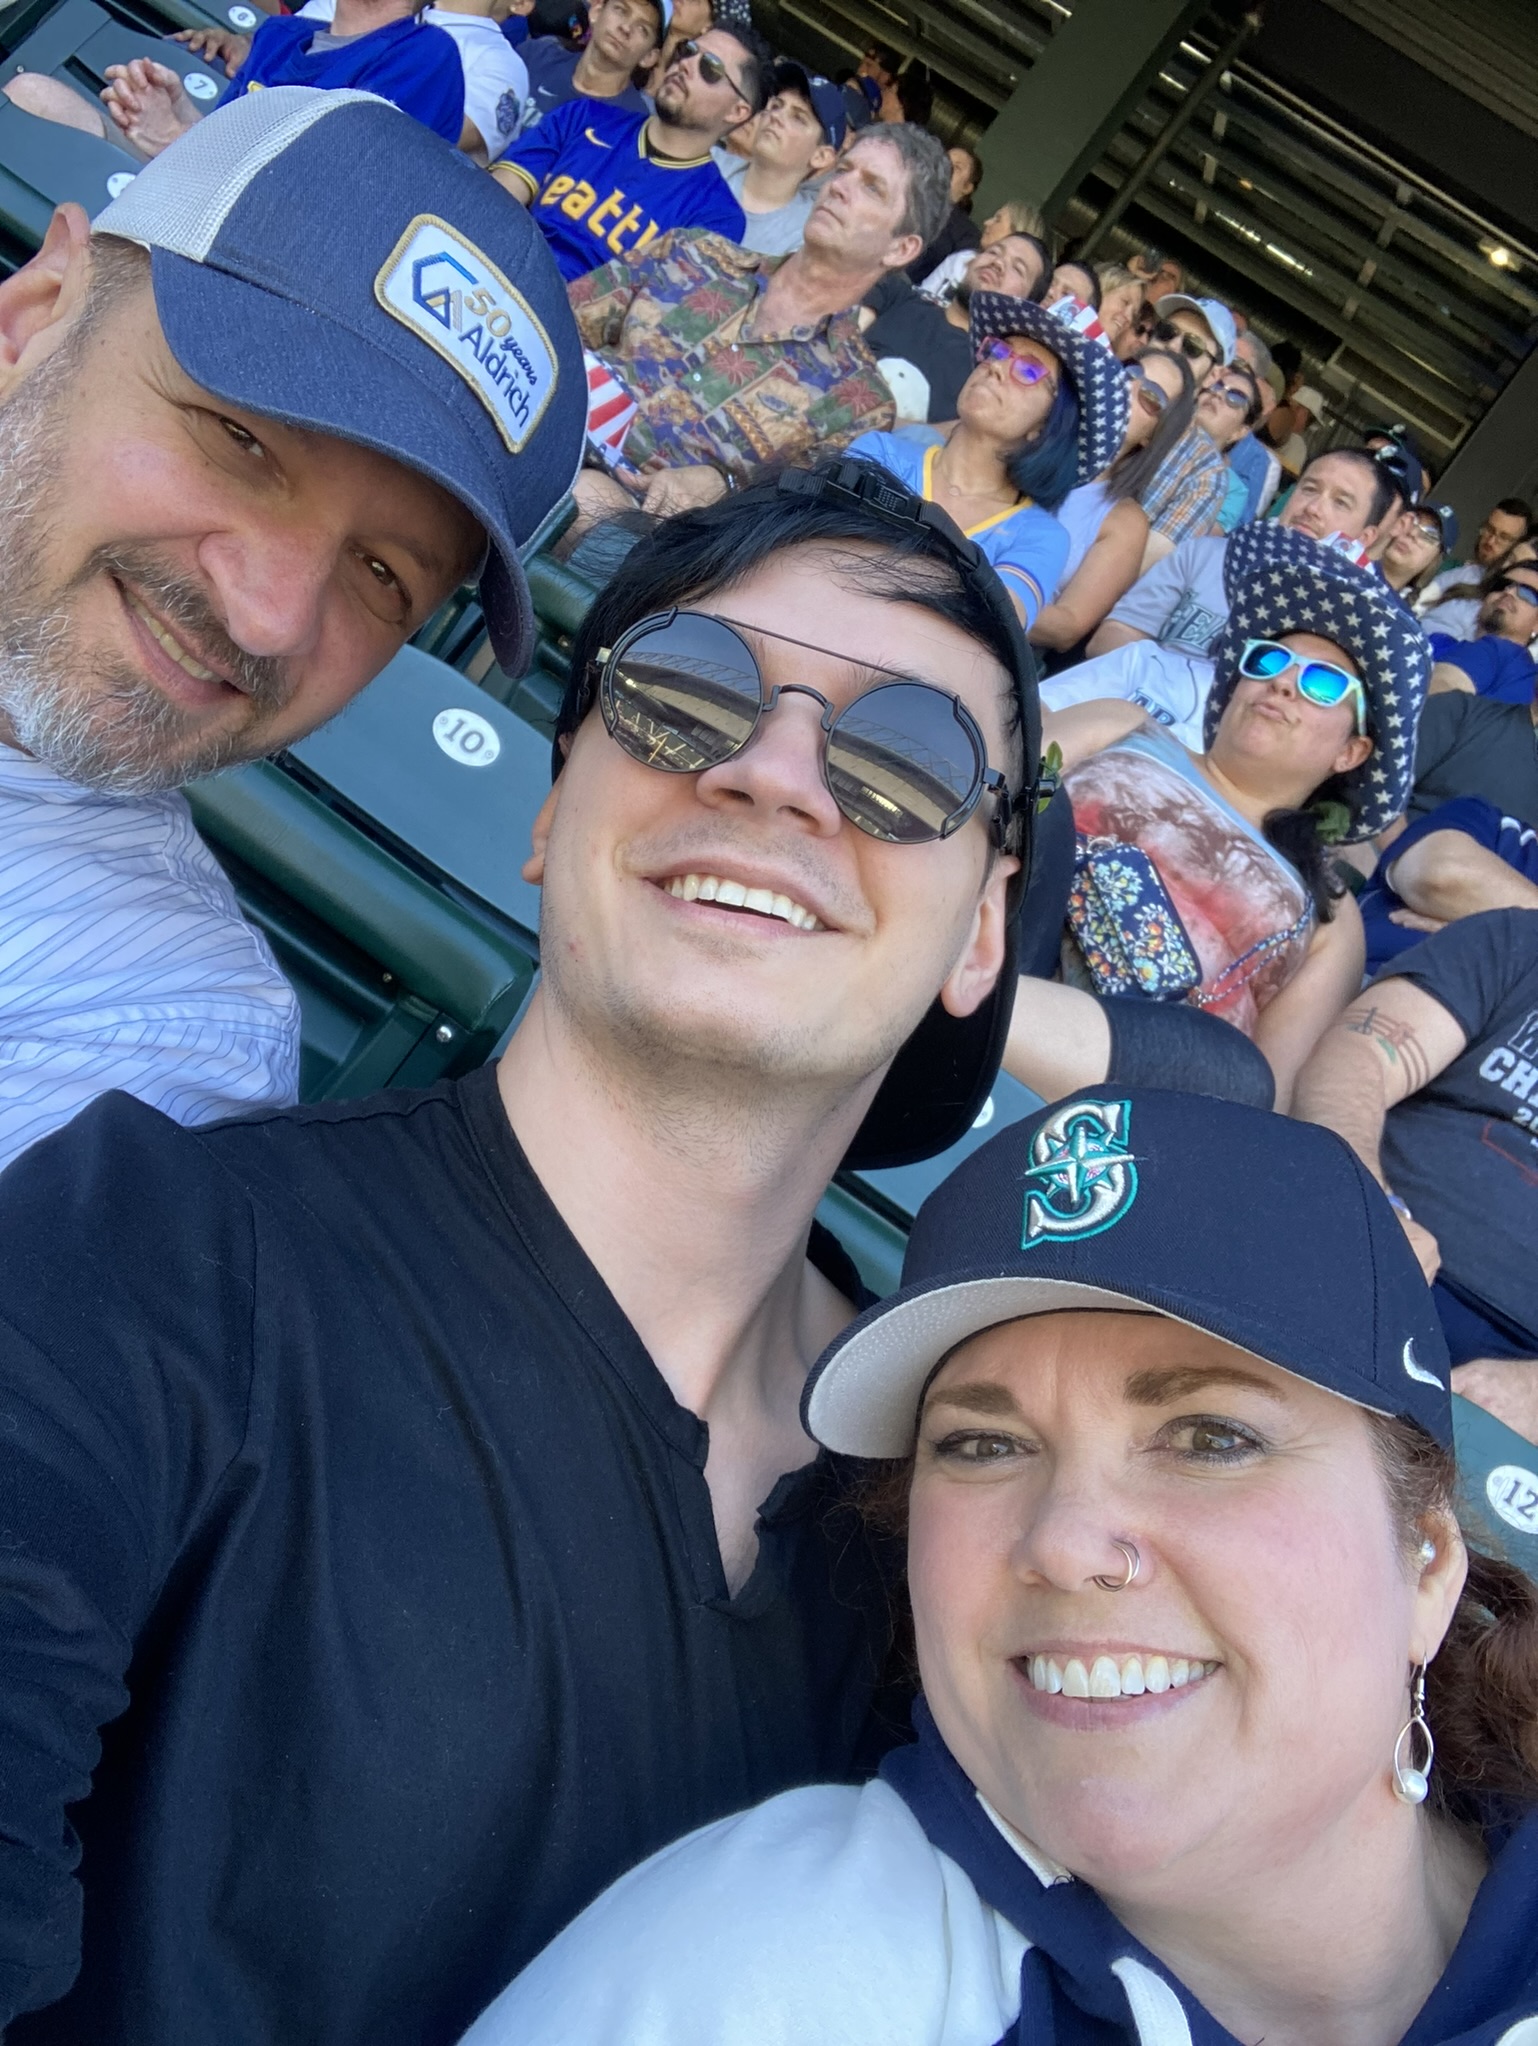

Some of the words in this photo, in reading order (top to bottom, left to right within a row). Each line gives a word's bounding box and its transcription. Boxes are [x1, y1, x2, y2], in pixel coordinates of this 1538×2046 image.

[458, 322, 530, 428] Aldrich
[463, 287, 512, 338] 50
[500, 335, 538, 386] years
[443, 718, 485, 754] 10
[1020, 1099, 1139, 1250] S
[1503, 1479, 1538, 1520] 12
